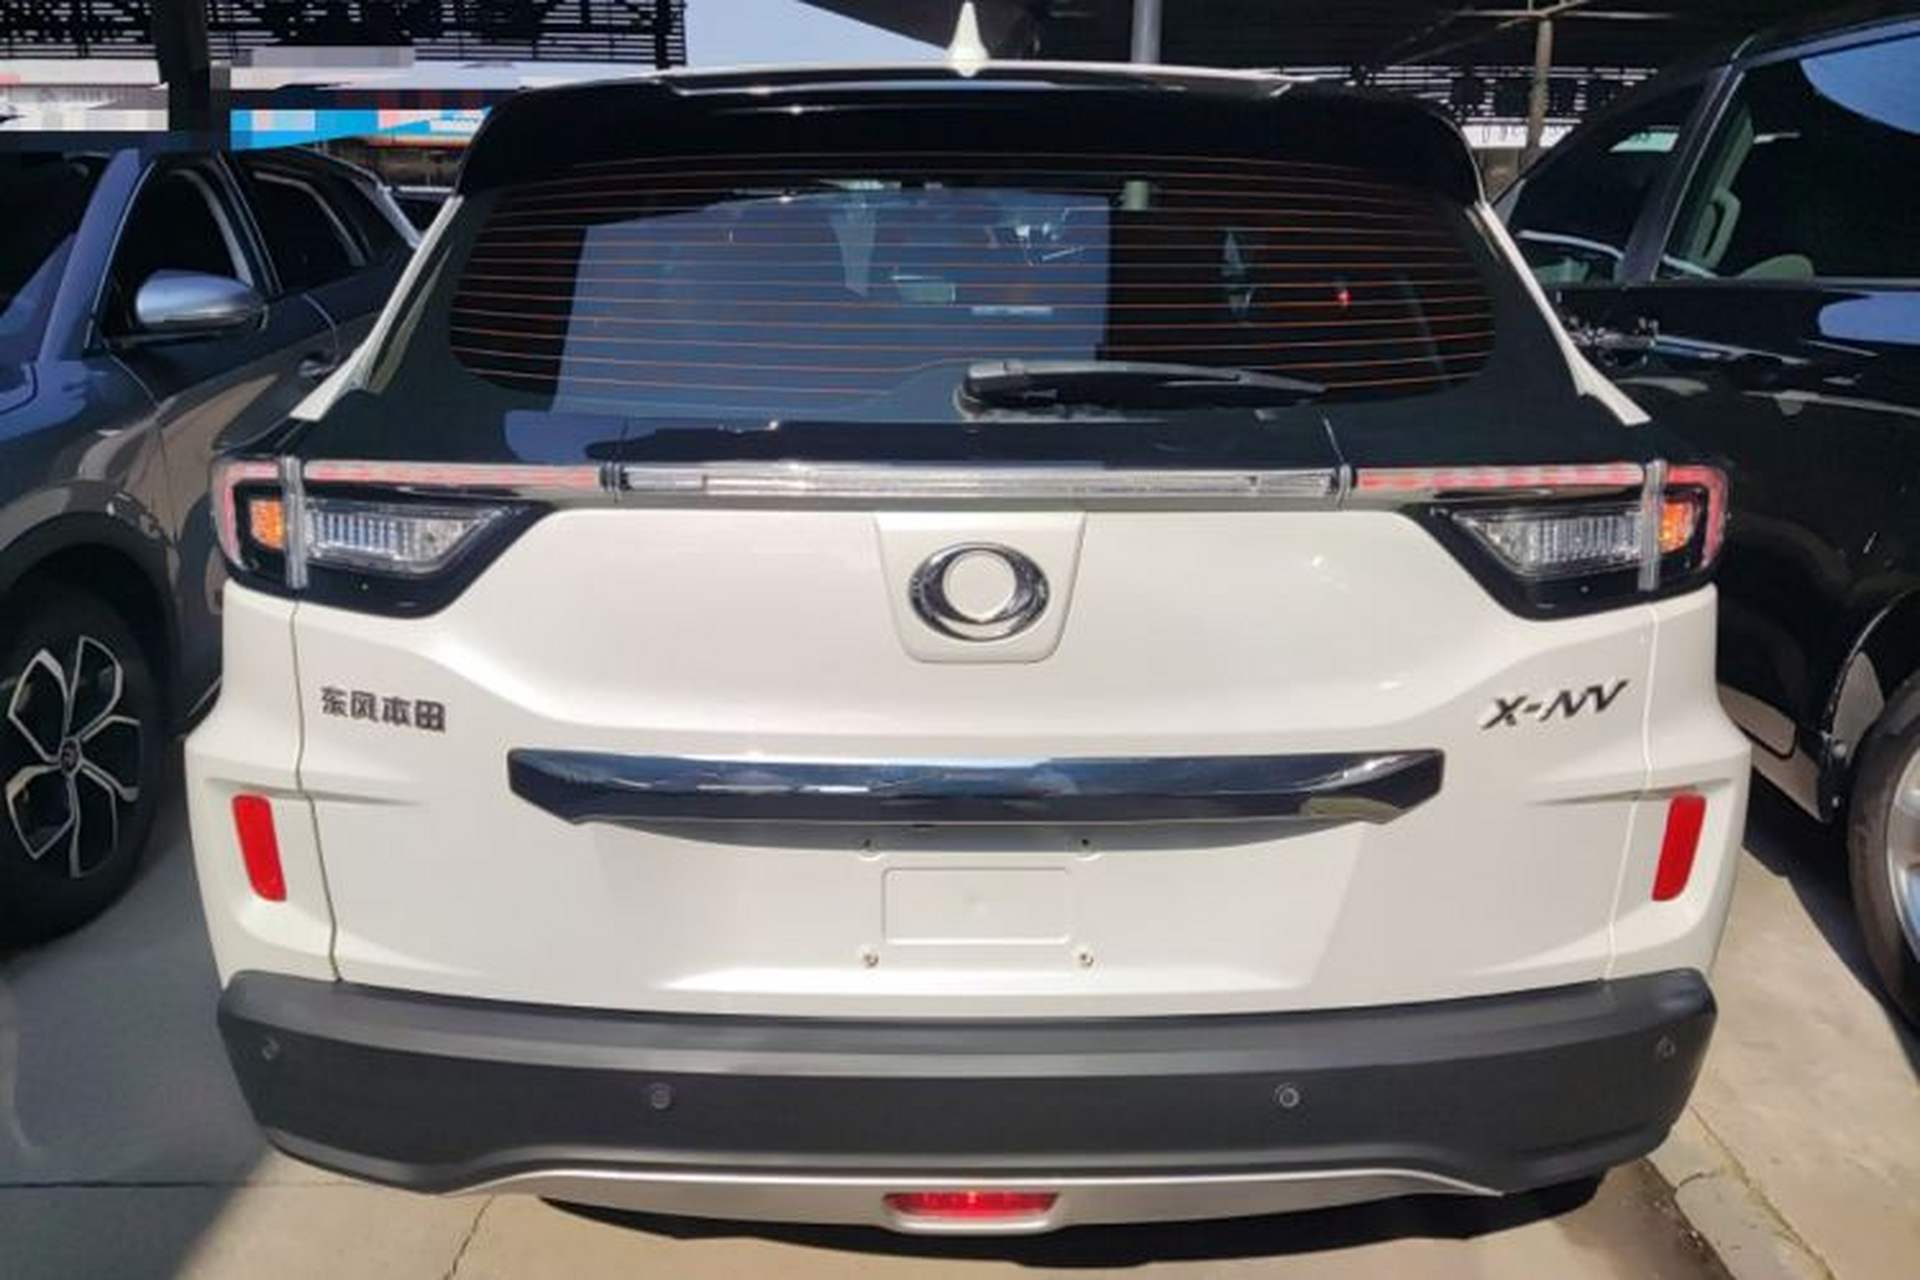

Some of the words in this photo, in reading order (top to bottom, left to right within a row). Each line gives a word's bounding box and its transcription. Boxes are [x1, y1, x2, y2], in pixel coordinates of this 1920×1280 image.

[321, 686, 446, 732] 东风本田
[1481, 679, 1629, 730] X-NV
